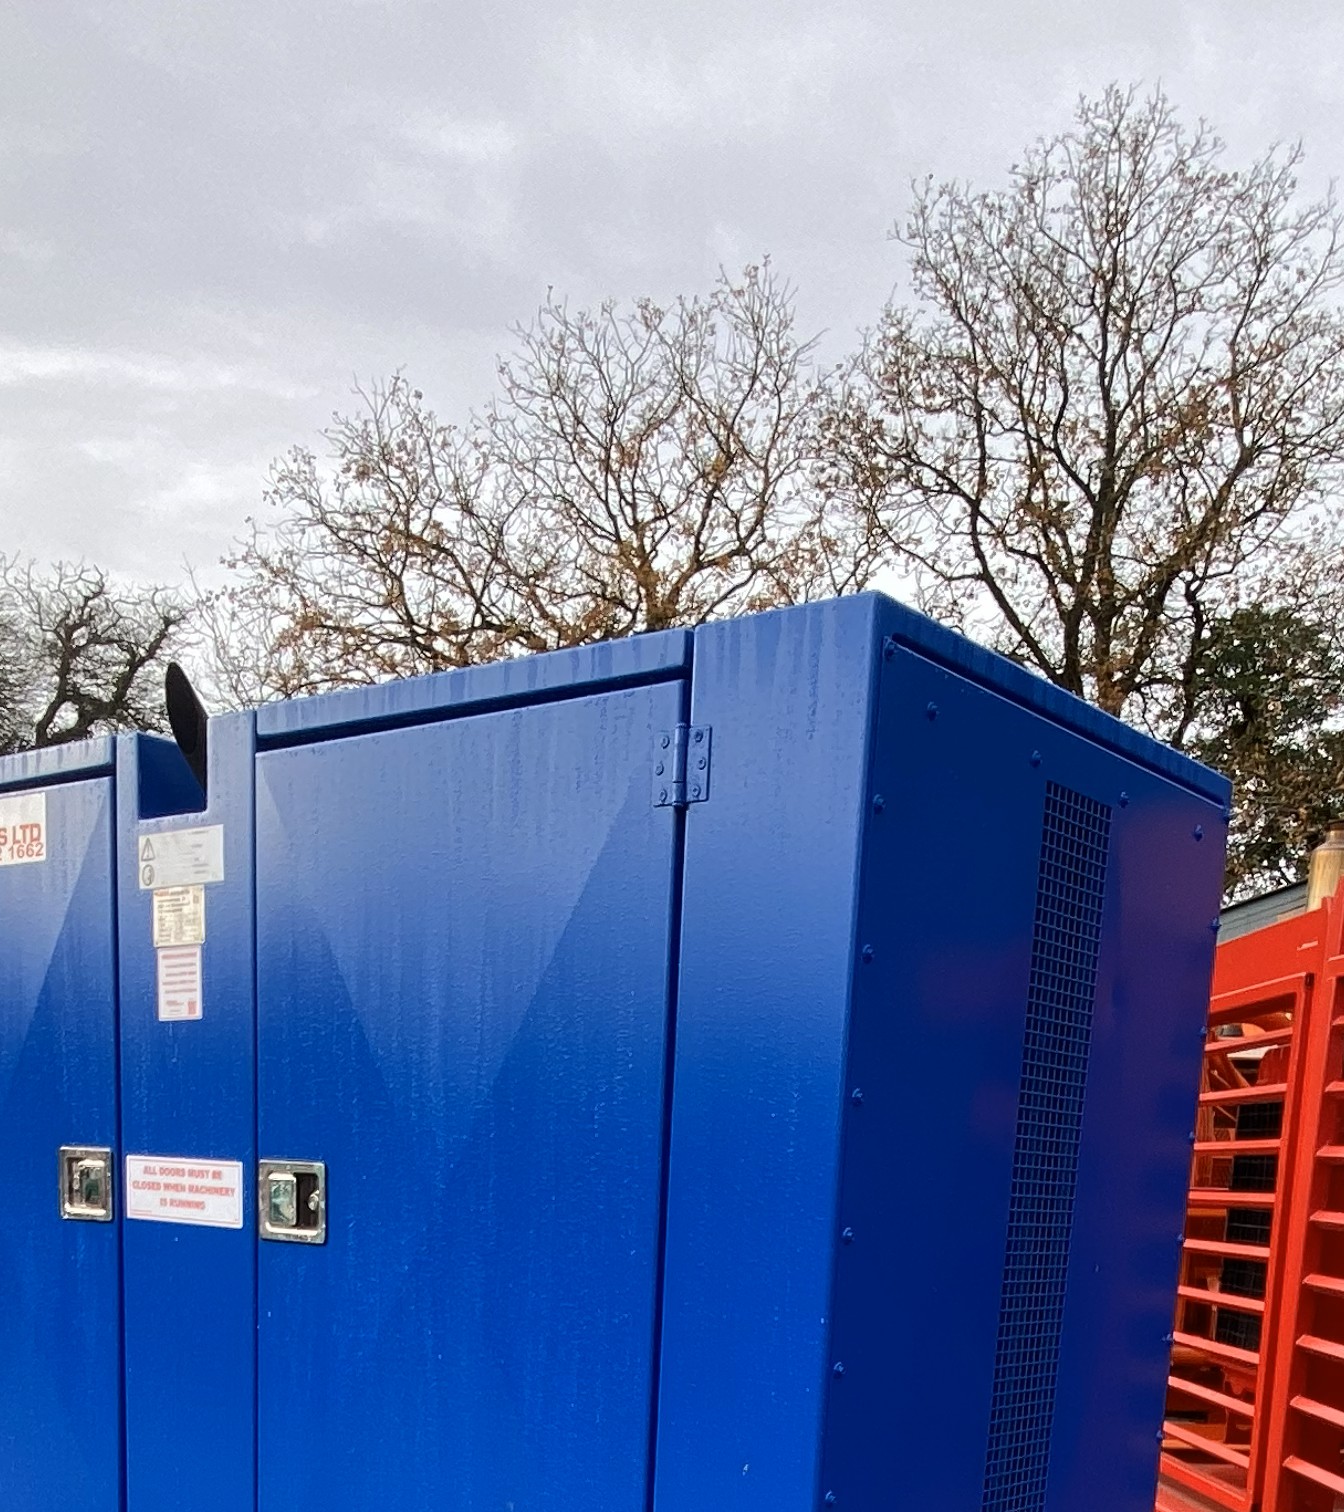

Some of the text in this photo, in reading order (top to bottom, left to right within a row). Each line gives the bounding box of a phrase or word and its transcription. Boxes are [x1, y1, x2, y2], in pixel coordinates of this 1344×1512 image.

[13, 823, 42, 845] LTD
[8, 842, 44, 860] 1662
[143, 1166, 222, 1180] ALL DOORS MUST BE
[132, 1180, 235, 1196] CLOSED WHEN MACHINERY
[160, 1198, 206, 1210] IS RUNNING
